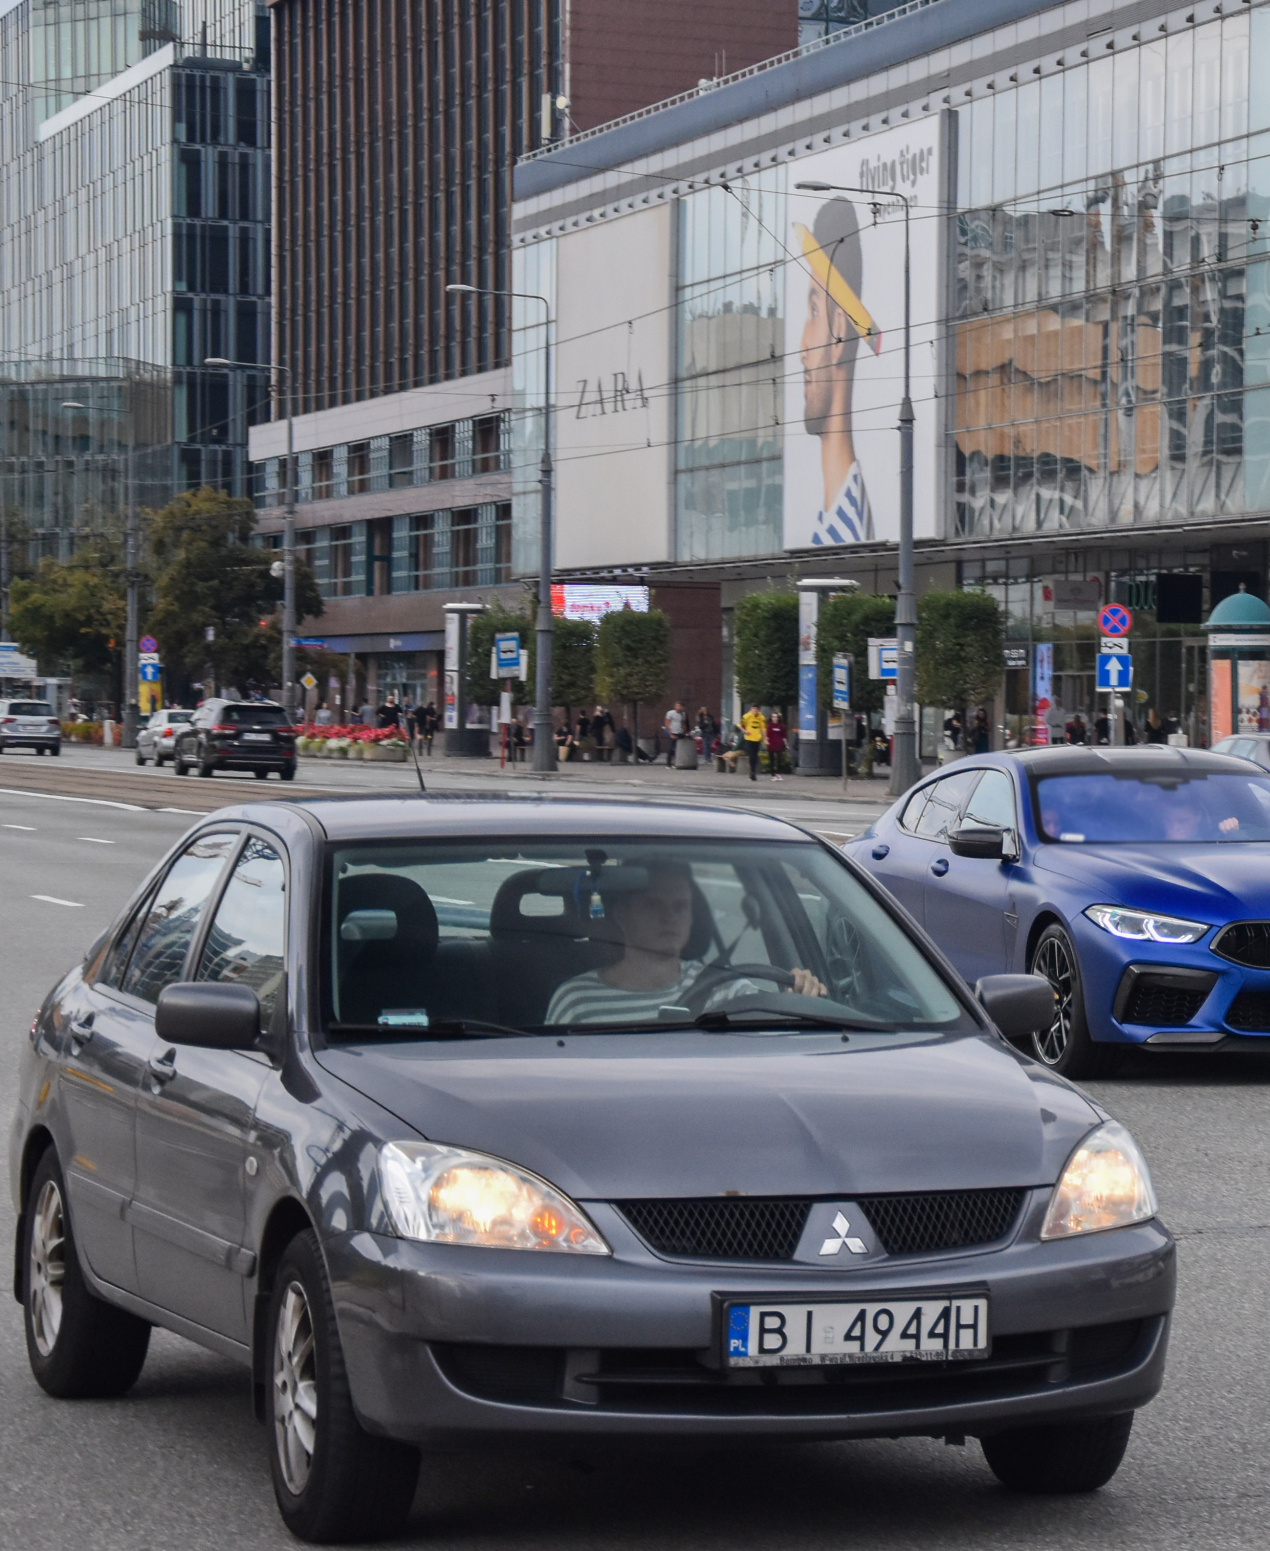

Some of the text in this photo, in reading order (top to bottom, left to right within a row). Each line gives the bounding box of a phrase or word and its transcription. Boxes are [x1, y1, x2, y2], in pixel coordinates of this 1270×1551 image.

[859, 143, 933, 200] flying tiger
[575, 367, 648, 419] ZARA
[730, 1339, 746, 1352] PL
[757, 1304, 980, 1355] BI 4944H
